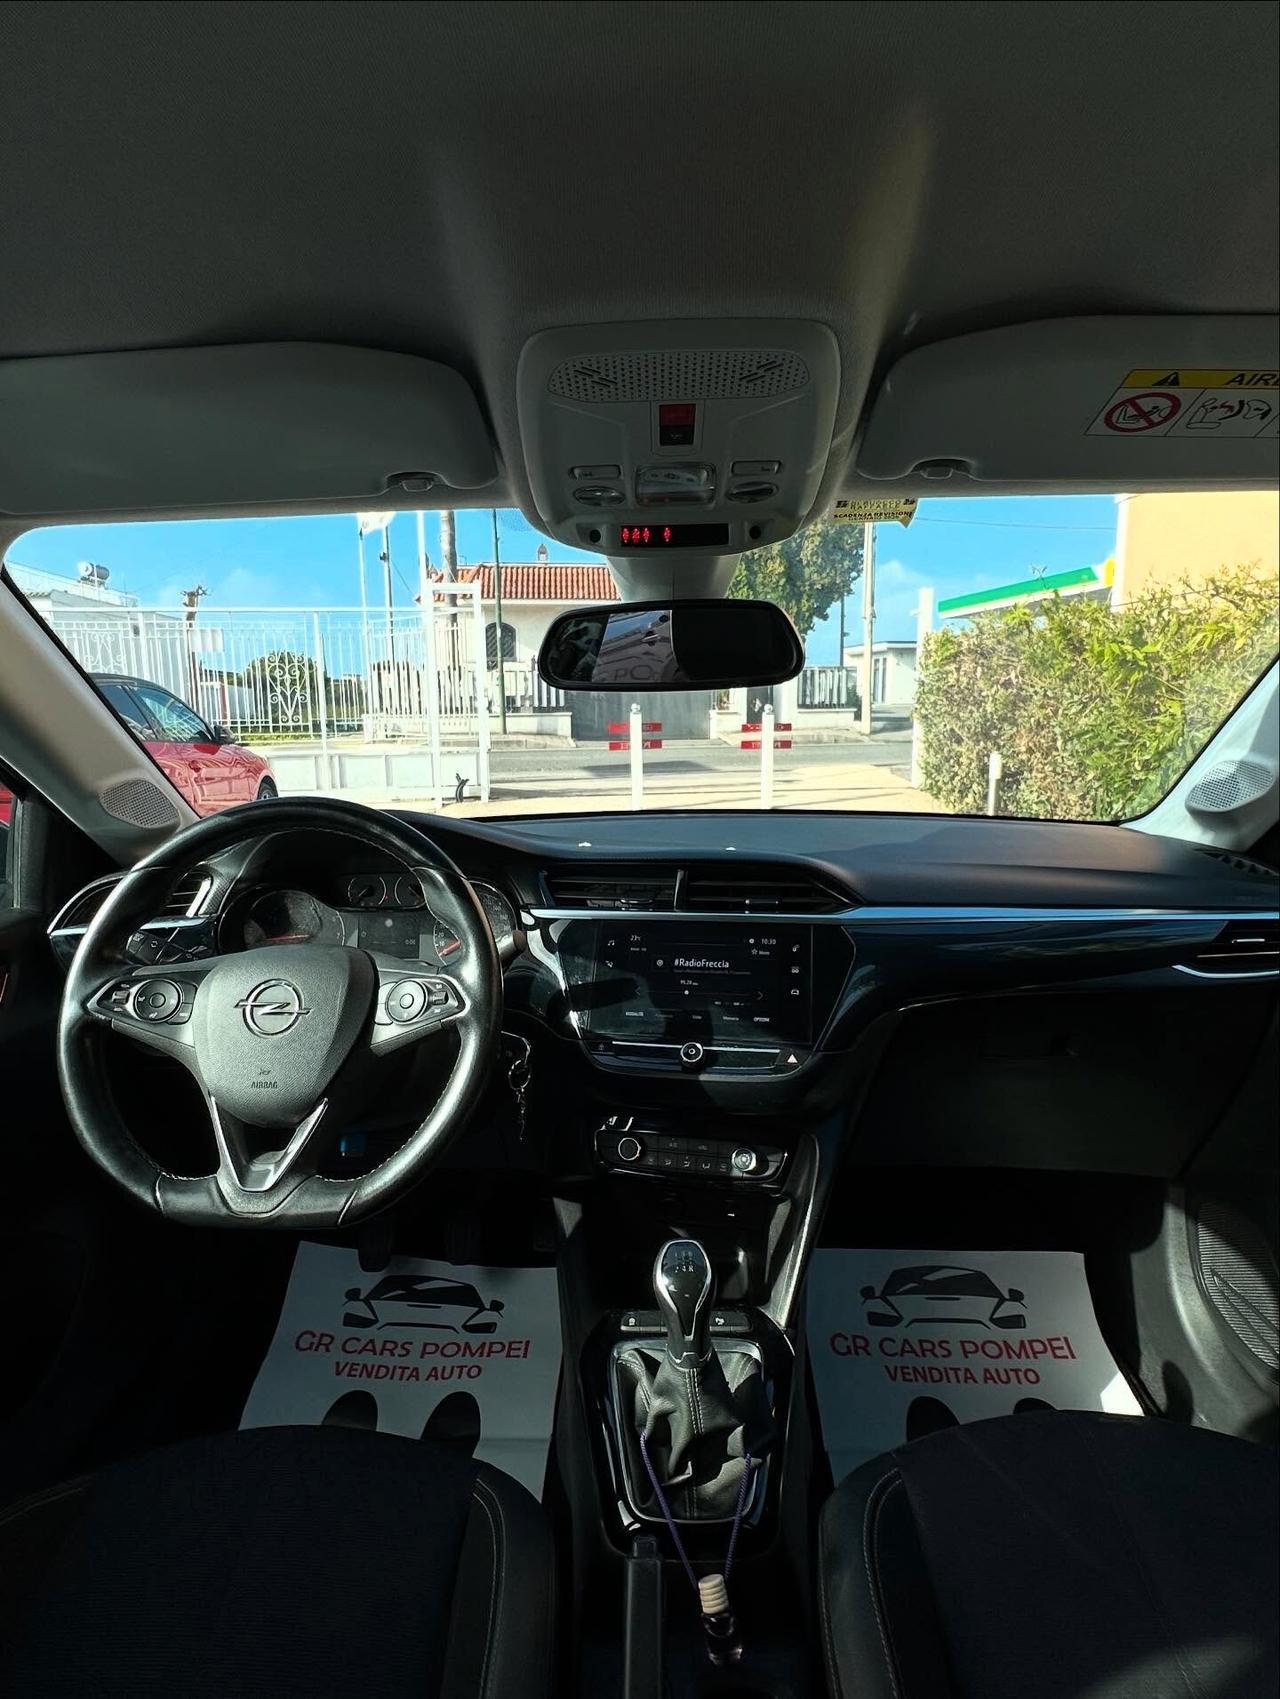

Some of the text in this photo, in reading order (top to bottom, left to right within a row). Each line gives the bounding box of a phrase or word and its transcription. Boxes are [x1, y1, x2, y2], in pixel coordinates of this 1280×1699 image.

[674, 958, 730, 968] #RadioFreccia
[250, 1080, 278, 1089] AIRBAG
[295, 1330, 531, 1359] GR CARS POMPEI
[830, 1332, 1077, 1360] GR CARS POMPEI
[334, 1361, 482, 1381] VENDITA AUTO
[884, 1365, 1040, 1385] VENDITA AUTO
